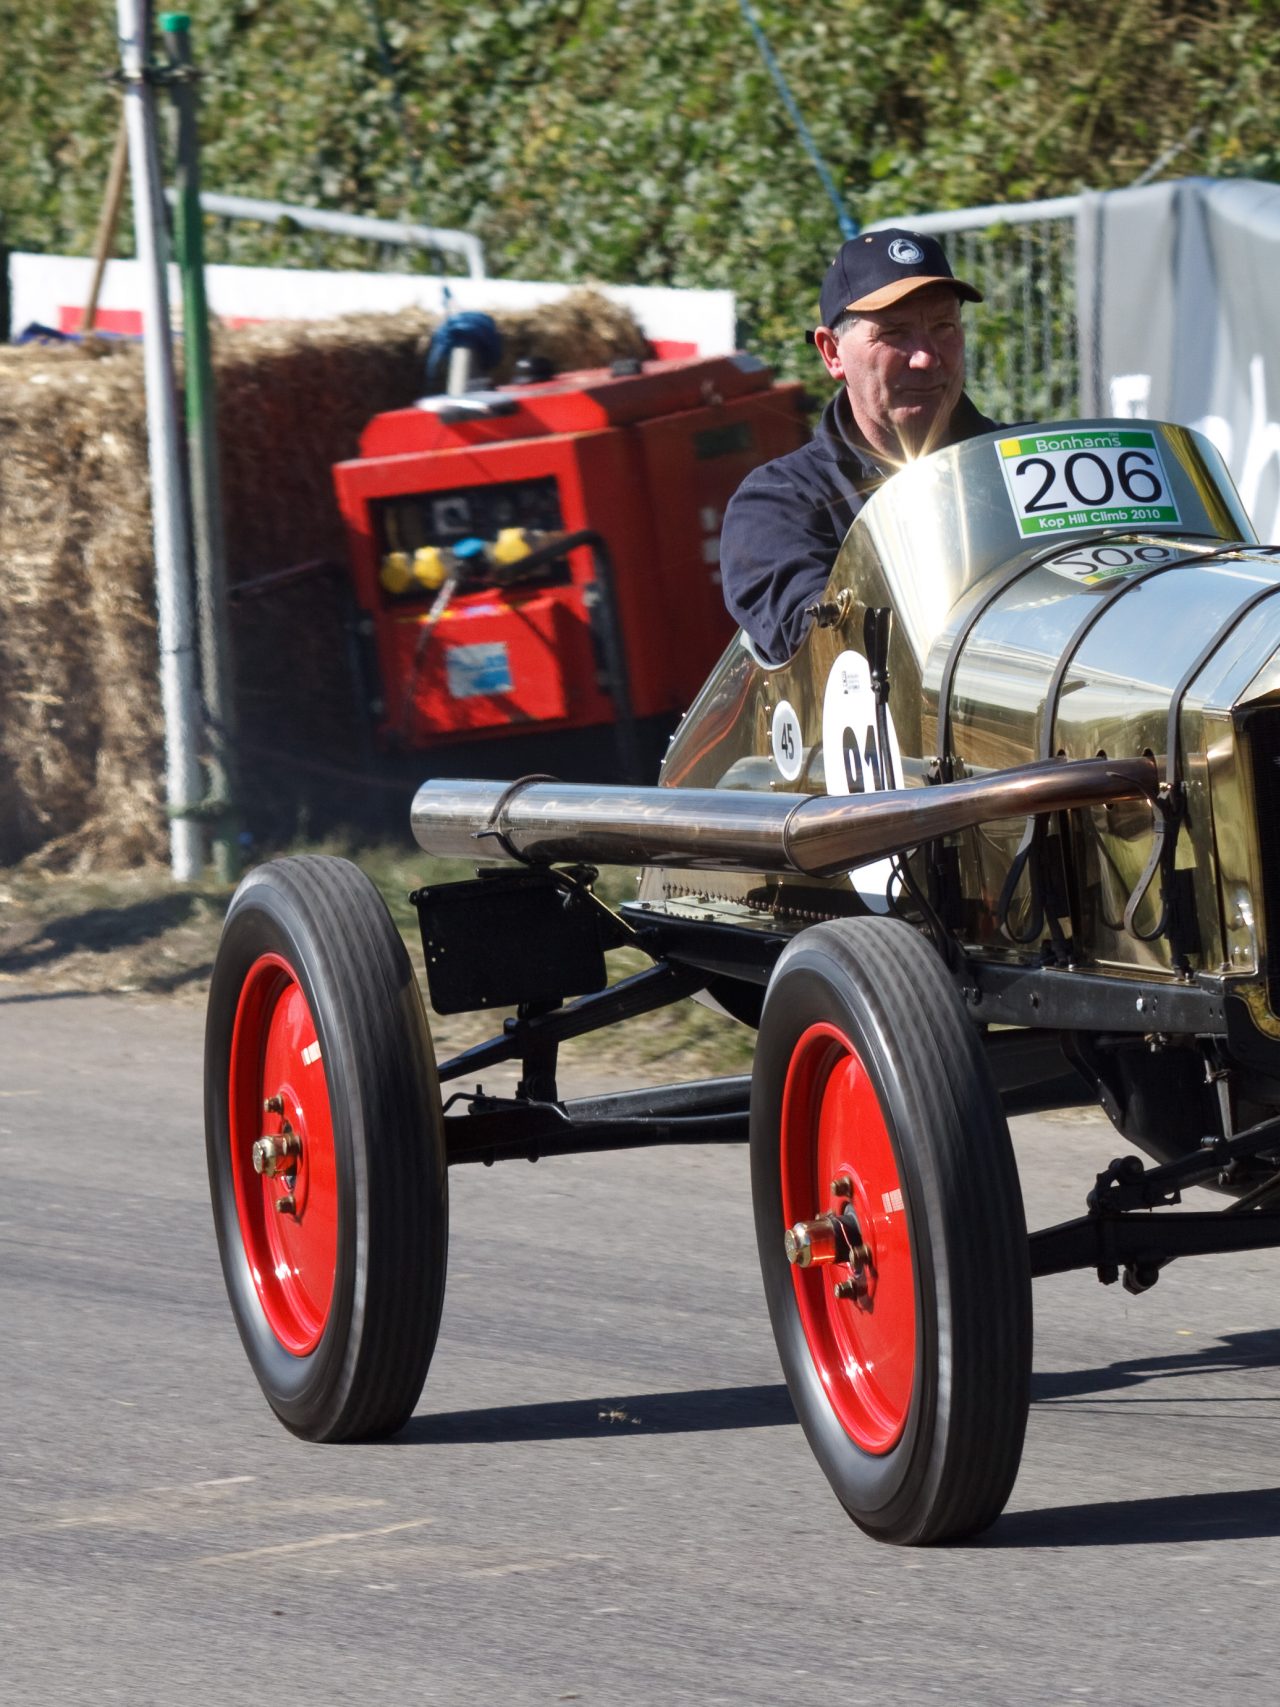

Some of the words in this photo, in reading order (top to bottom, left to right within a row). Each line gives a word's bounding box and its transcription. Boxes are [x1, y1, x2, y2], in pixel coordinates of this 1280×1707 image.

[1036, 436, 1122, 452] Bonhams
[1015, 451, 1163, 514] 206
[1038, 518, 1066, 529] Kop
[1068, 512, 1088, 525] Hill
[1090, 510, 1128, 522] Climb
[1131, 509, 1161, 520] 2010
[781, 722, 795, 760] 45
